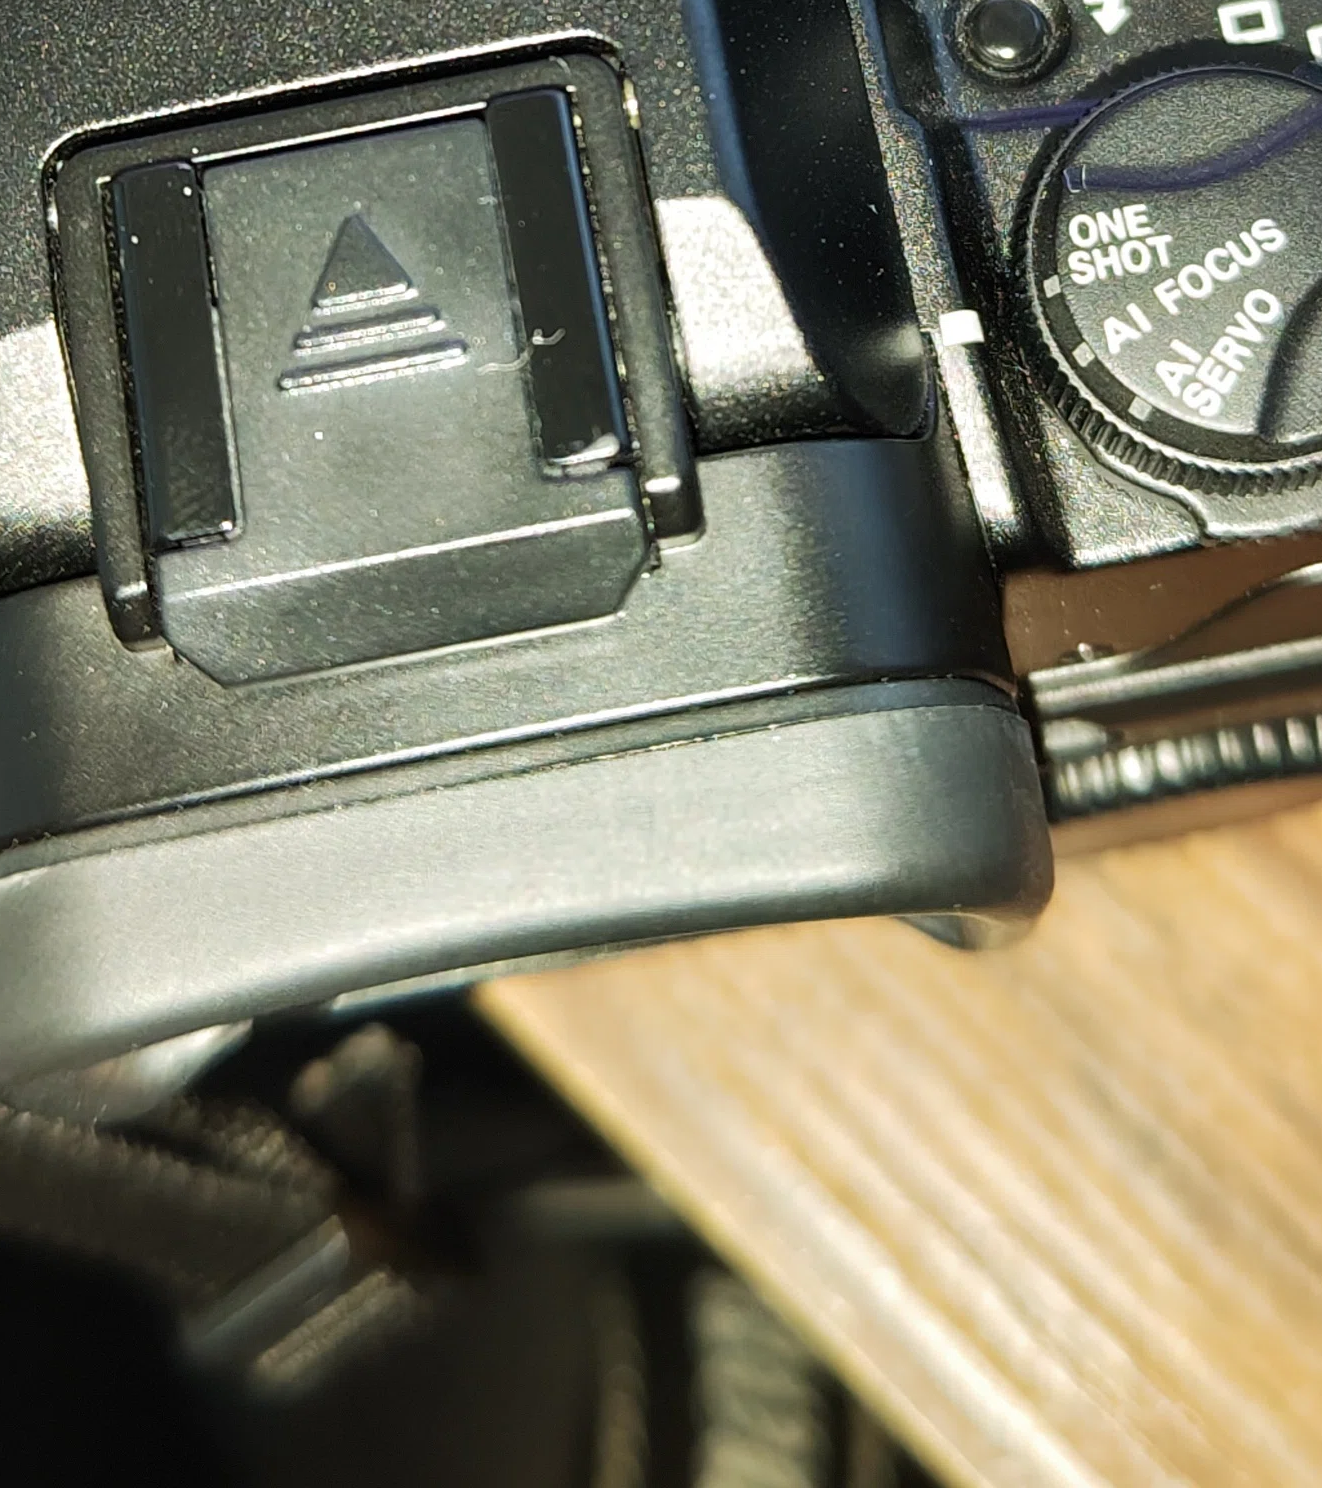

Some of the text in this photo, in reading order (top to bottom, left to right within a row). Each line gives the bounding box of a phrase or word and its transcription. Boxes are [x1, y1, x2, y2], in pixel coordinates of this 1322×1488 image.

[1068, 203, 1155, 249] ONE
[1067, 234, 1173, 285] SHOT
[1101, 218, 1289, 355] AI FOCUS
[1154, 339, 1203, 397] AI
[1182, 288, 1284, 416] SERVO
